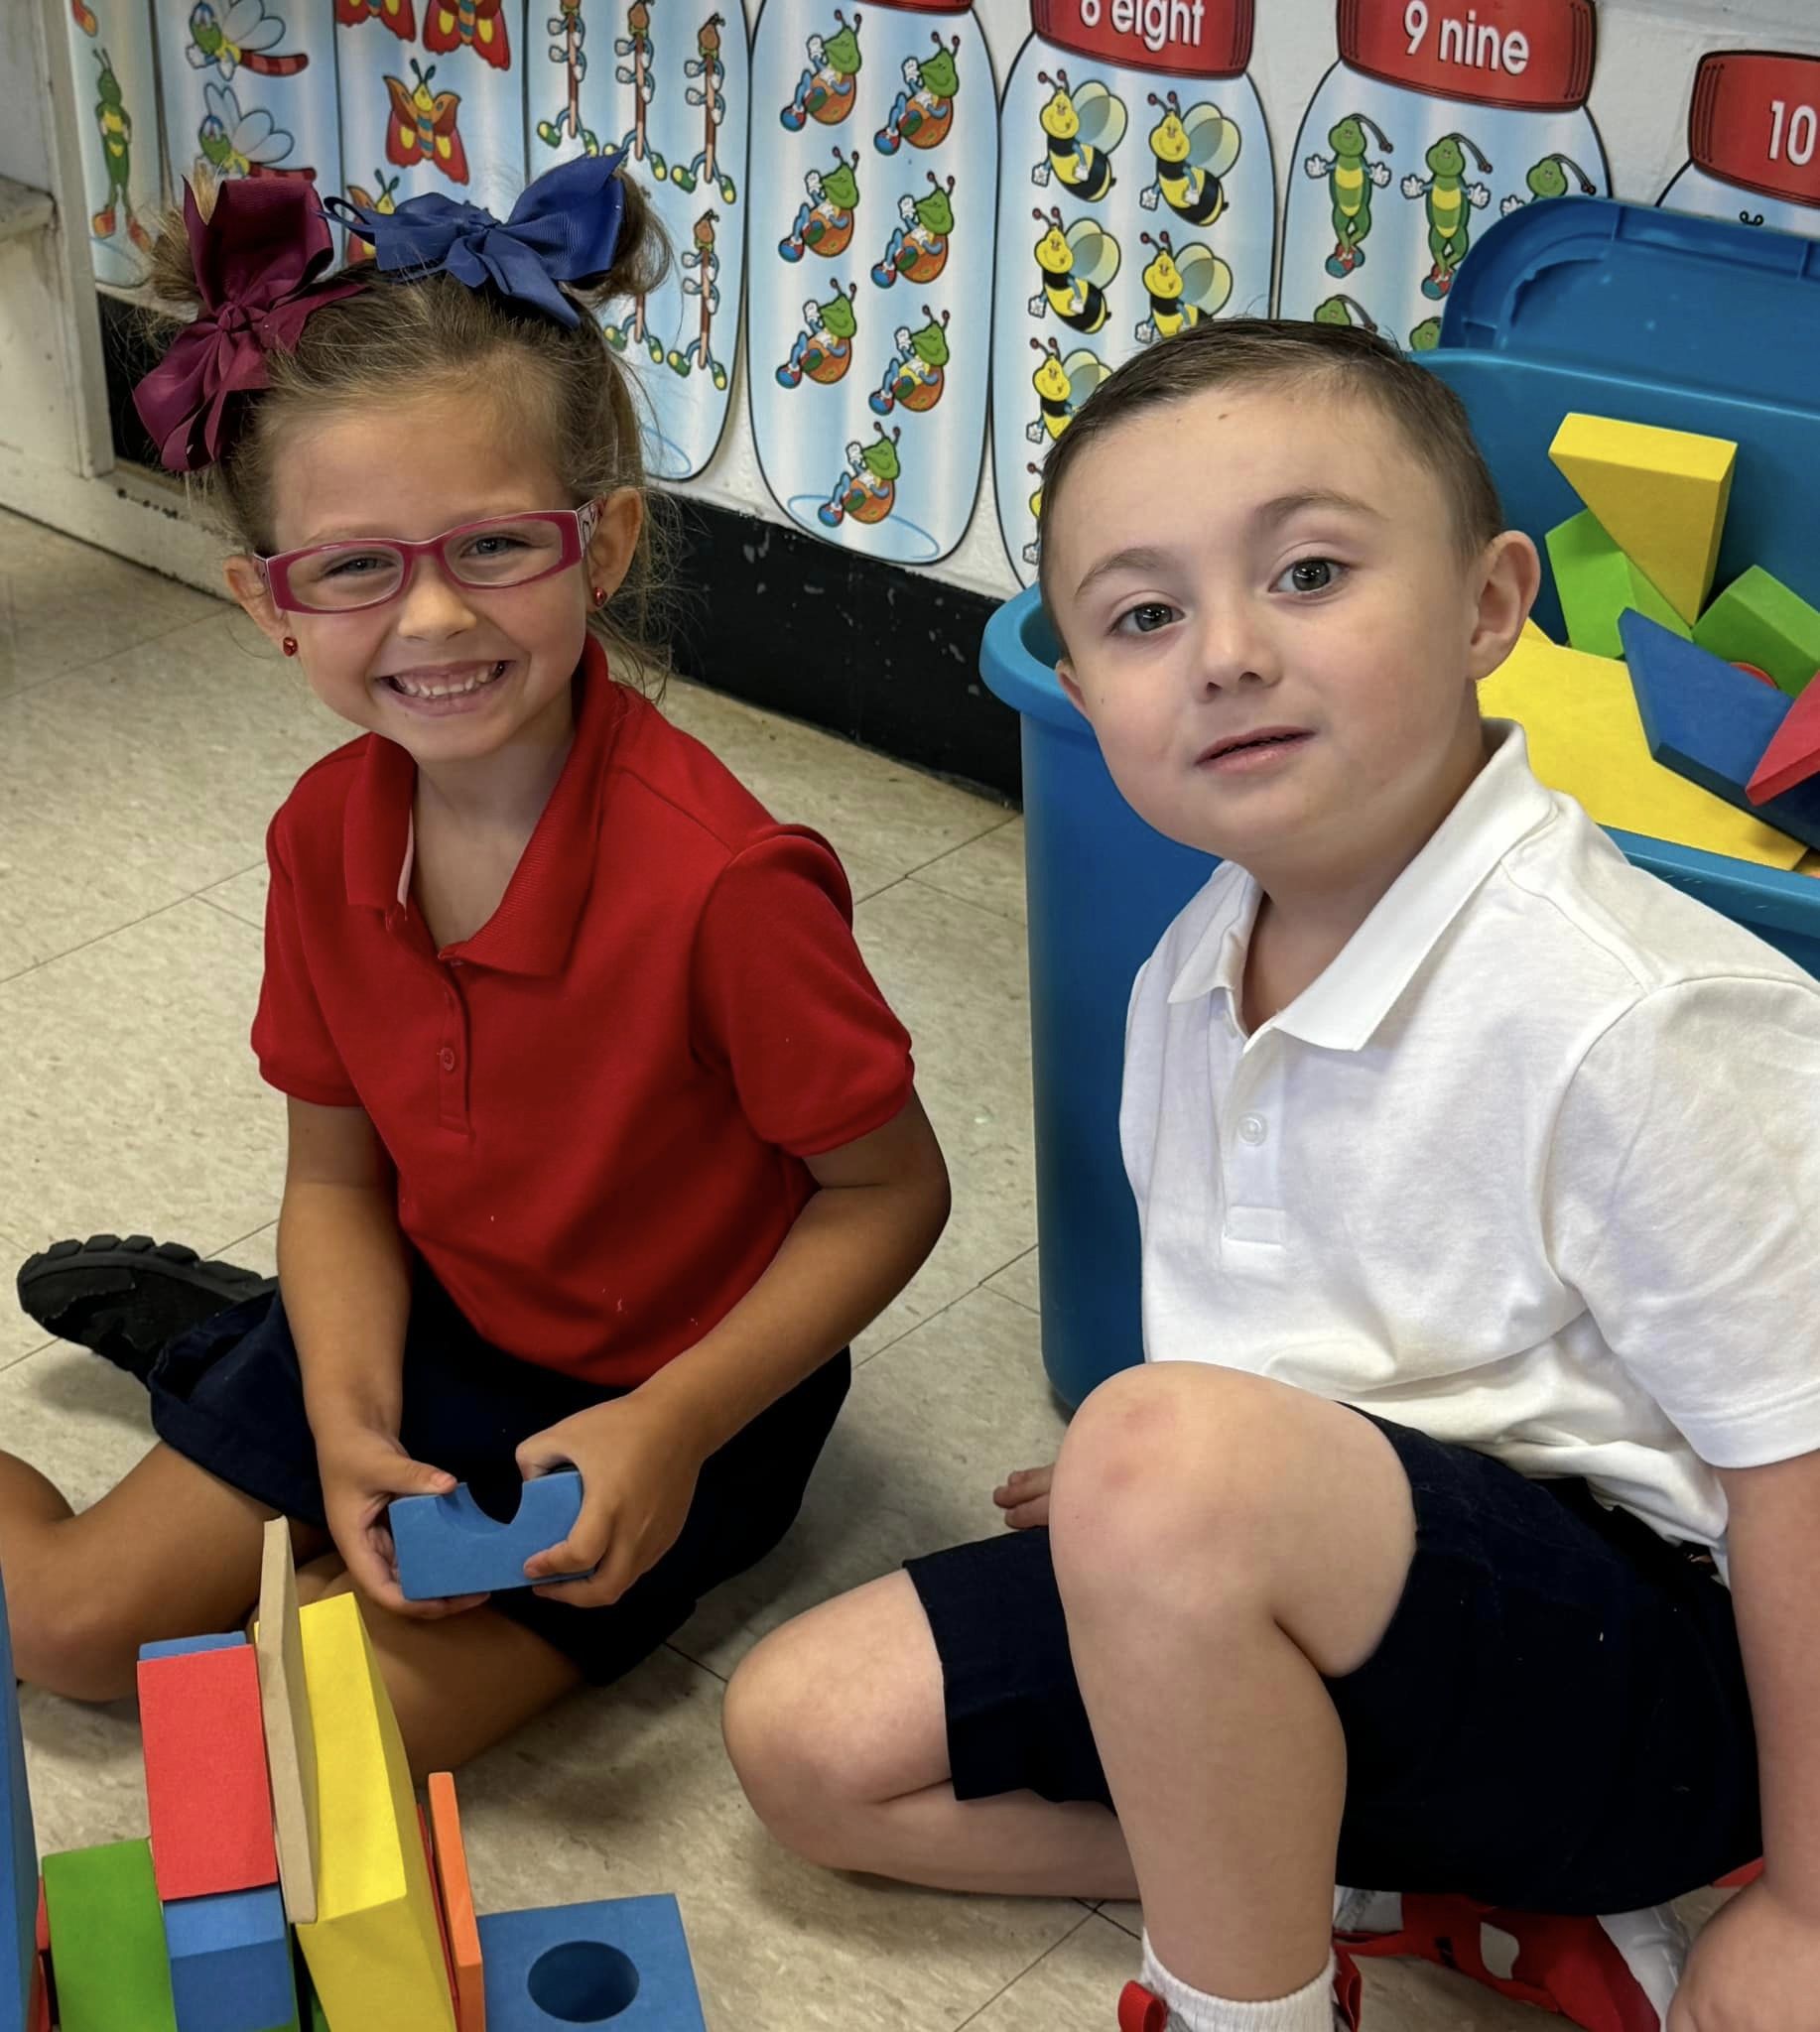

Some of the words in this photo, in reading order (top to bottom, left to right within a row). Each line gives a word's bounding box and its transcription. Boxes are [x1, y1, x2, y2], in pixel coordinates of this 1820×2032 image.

[1111, 0, 1205, 51] eight
[1404, 0, 1429, 55] 9
[1439, 10, 1529, 75] nine
[1769, 100, 1818, 166] 10
